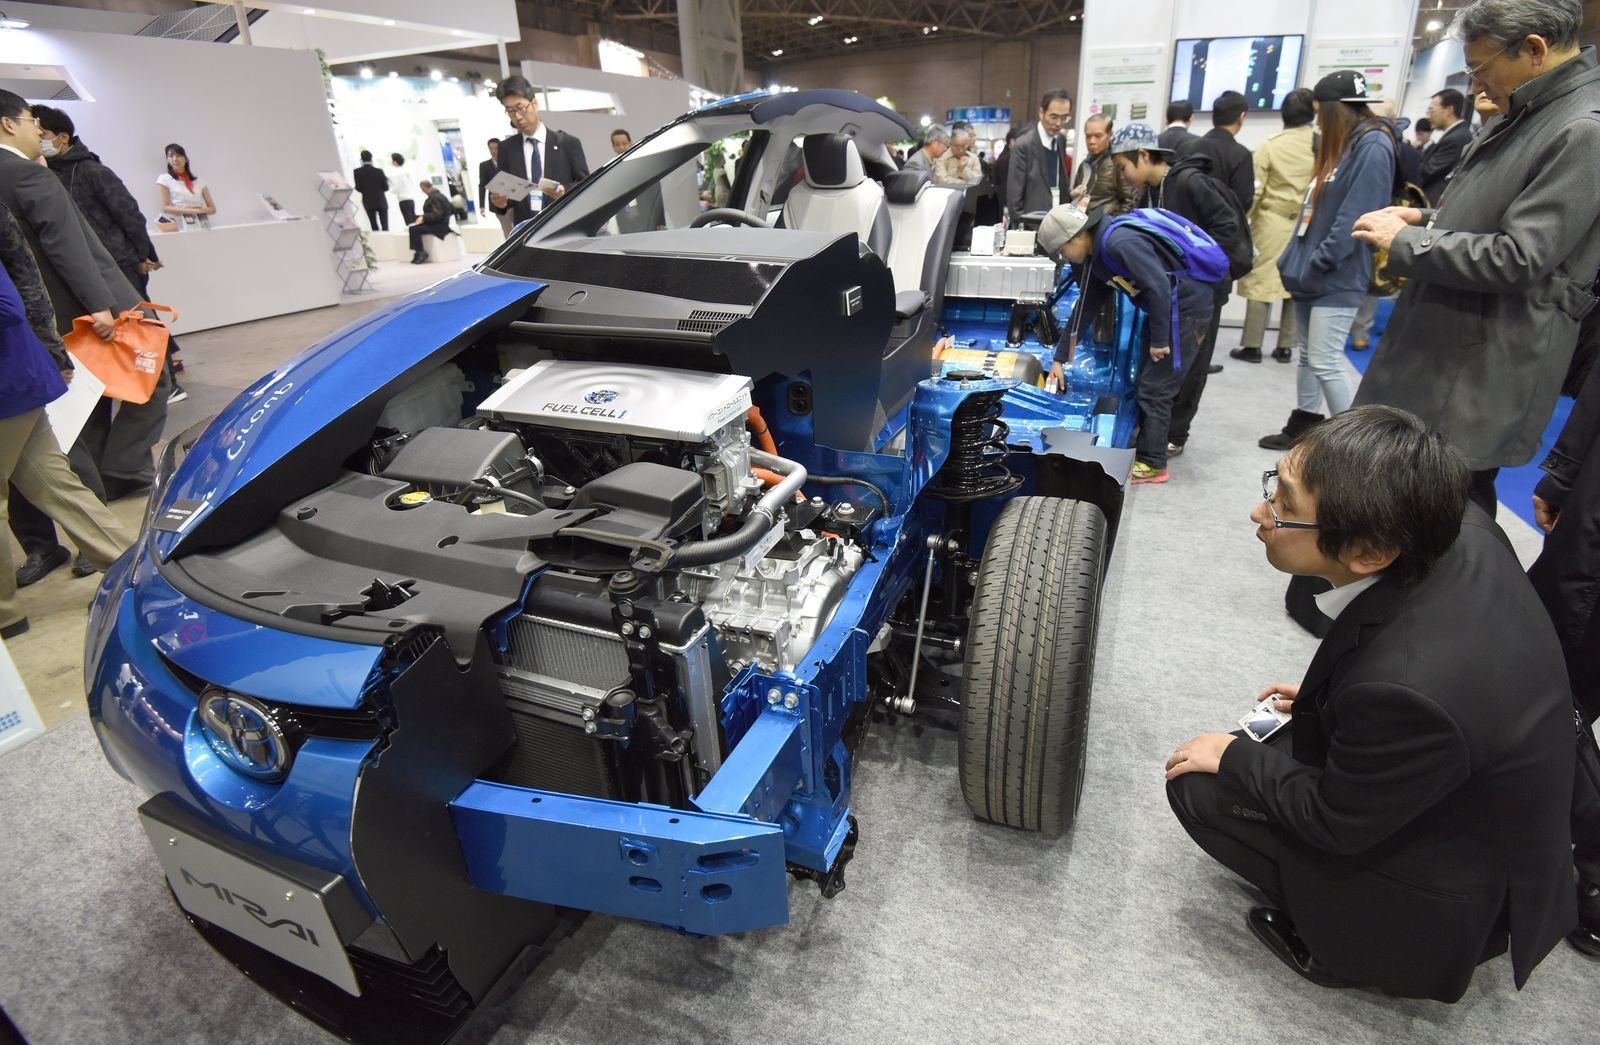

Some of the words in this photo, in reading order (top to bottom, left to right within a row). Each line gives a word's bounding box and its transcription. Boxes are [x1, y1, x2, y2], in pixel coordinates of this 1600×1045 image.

[542, 403, 578, 414] FUEL
[580, 406, 616, 419] CELL
[180, 867, 320, 947] MIRAI
